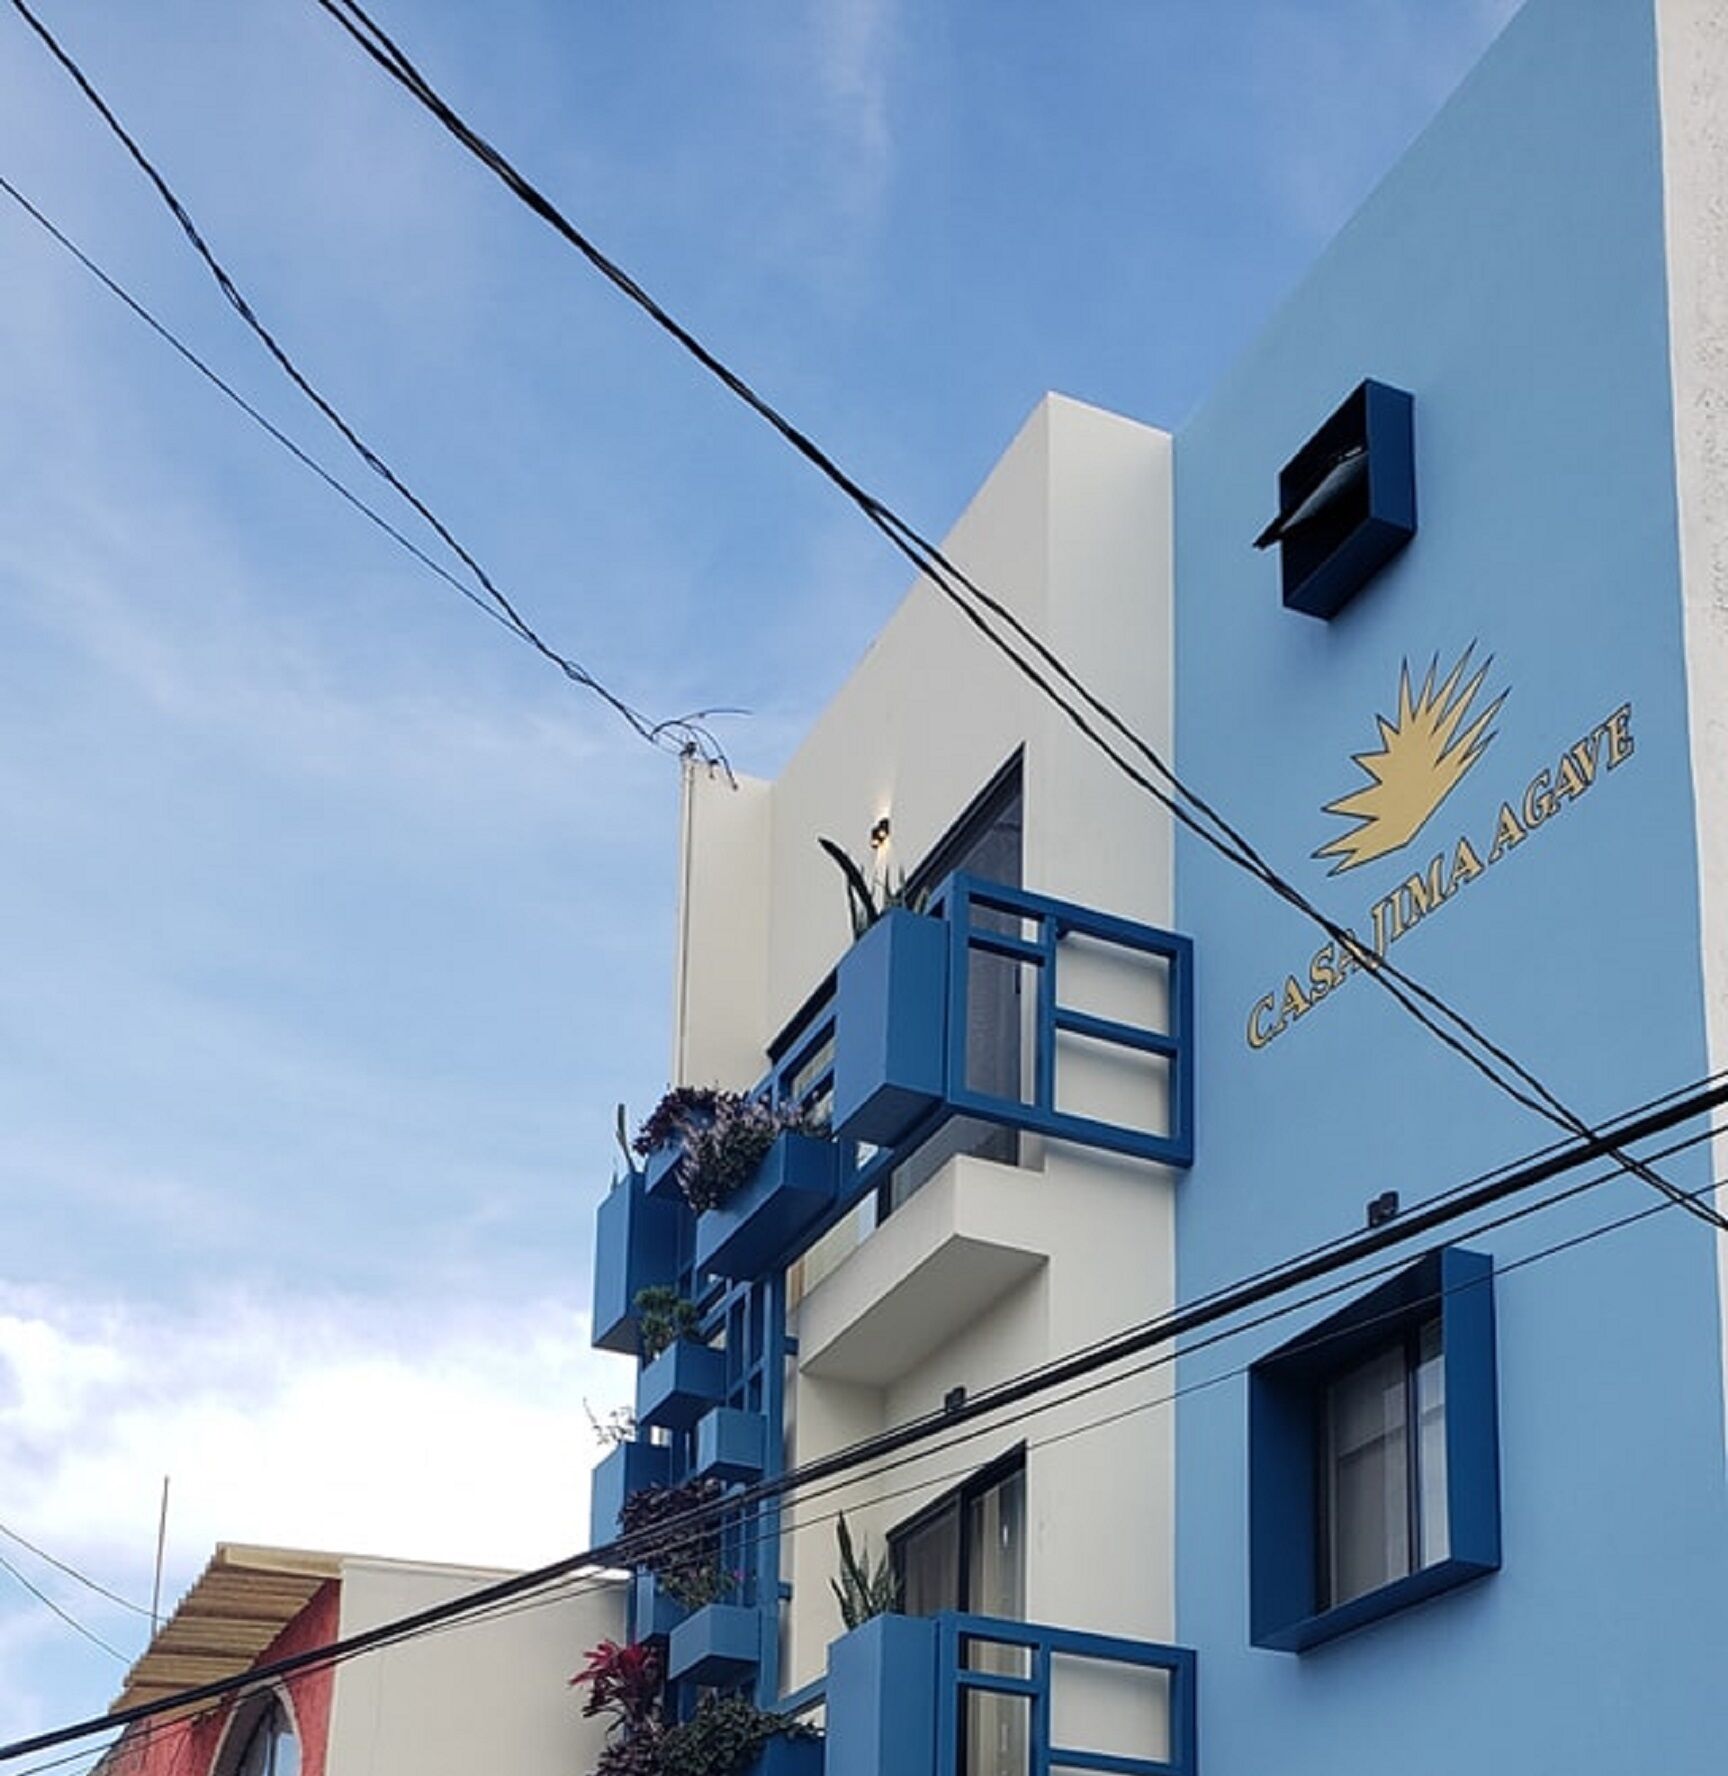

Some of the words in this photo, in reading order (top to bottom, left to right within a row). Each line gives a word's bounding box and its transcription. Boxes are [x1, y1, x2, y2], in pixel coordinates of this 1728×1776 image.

[1246, 929, 1376, 1048] CASA
[1366, 836, 1486, 970] JIMA
[1488, 702, 1635, 865] AGAVE
